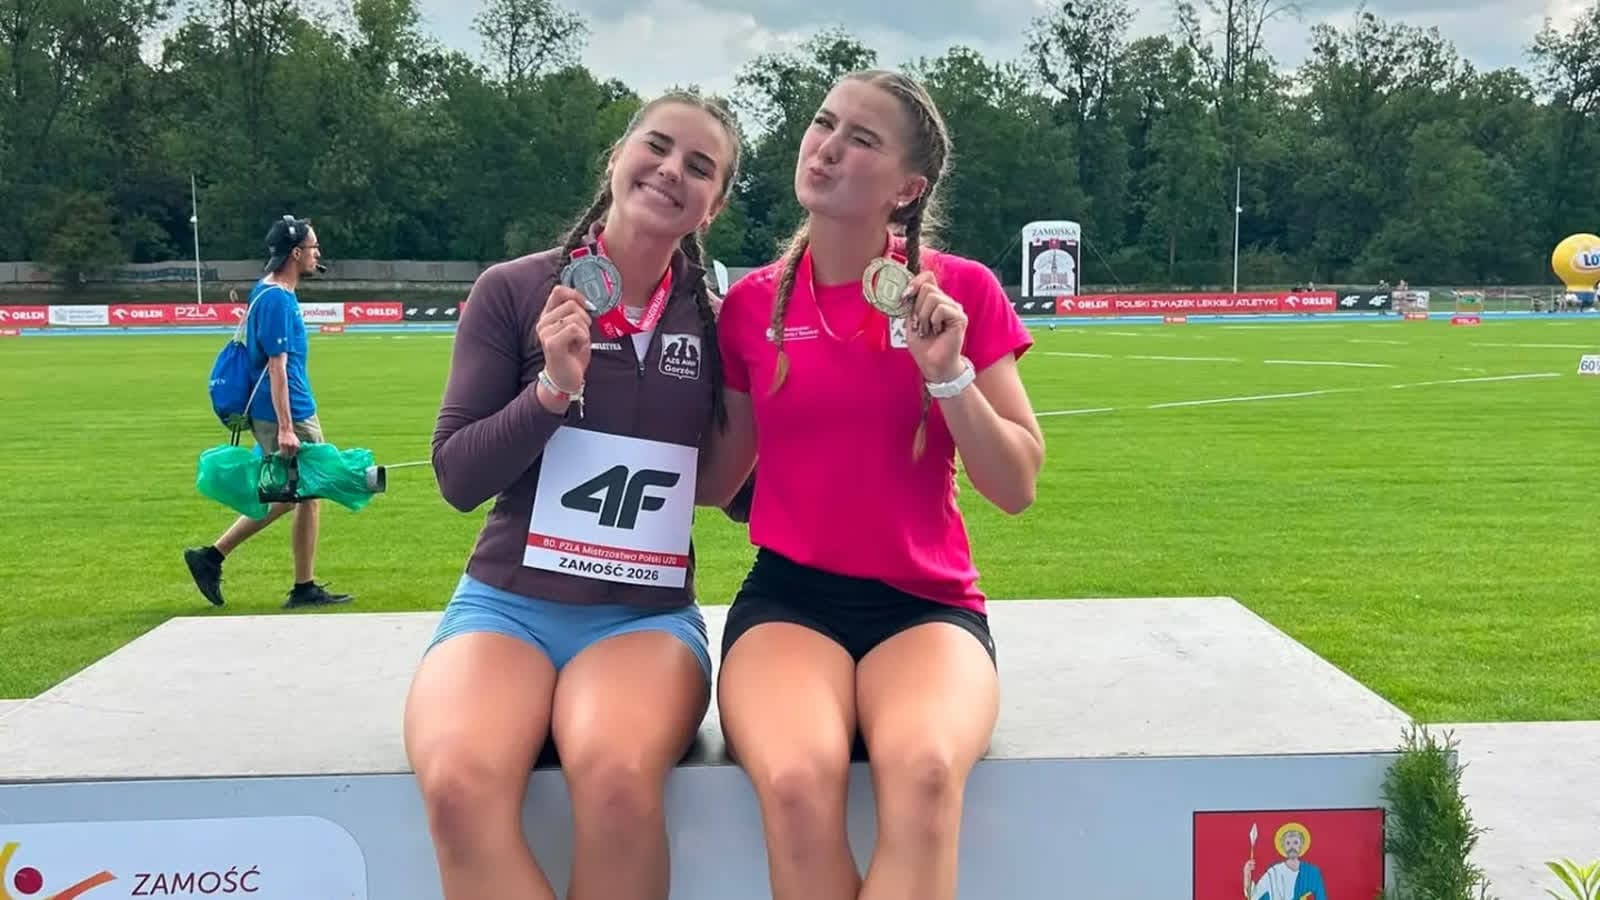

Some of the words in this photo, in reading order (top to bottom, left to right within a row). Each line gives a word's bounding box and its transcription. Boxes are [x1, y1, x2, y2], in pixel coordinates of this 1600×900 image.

[1584, 254, 1600, 266] LO
[1077, 299, 1109, 309] ORLEN
[1115, 300, 1150, 309] POLSKI
[1299, 296, 1333, 306] ORLEN
[1340, 295, 1360, 307] 4F
[1369, 295, 1388, 307] 4F
[12, 311, 45, 320] ORLEN
[130, 310, 163, 318] ORLEN
[174, 306, 217, 318] PZLA
[366, 308, 399, 316] ORLEN
[664, 364, 695, 376] Gorzów
[561, 465, 681, 529] 4F
[559, 542, 581, 554] PZLA
[582, 545, 638, 562] Mistrzostwa
[638, 553, 662, 564] Polski
[558, 556, 624, 578] ZAMOŚĆ
[626, 567, 660, 581] 2026
[131, 865, 261, 896] ZAMOŚĆ
